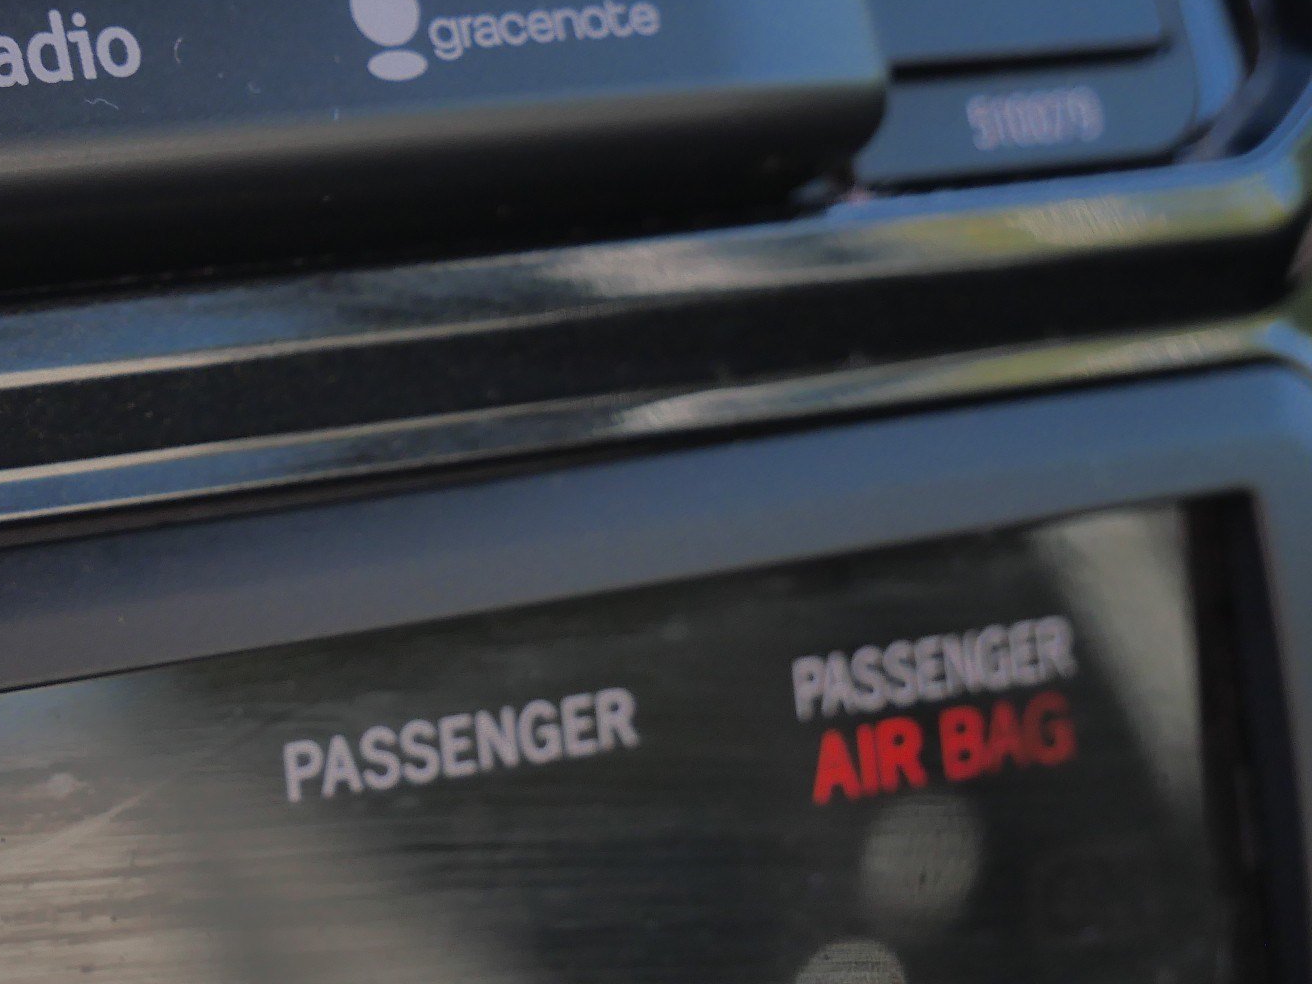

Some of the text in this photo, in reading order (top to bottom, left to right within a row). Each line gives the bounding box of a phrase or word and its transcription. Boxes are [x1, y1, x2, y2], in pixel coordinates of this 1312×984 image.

[428, 0, 661, 61] gracenote
[791, 615, 1078, 724] PASSENGER
[283, 686, 641, 803] PASSENGER
[812, 691, 1078, 807] AIR BAG
